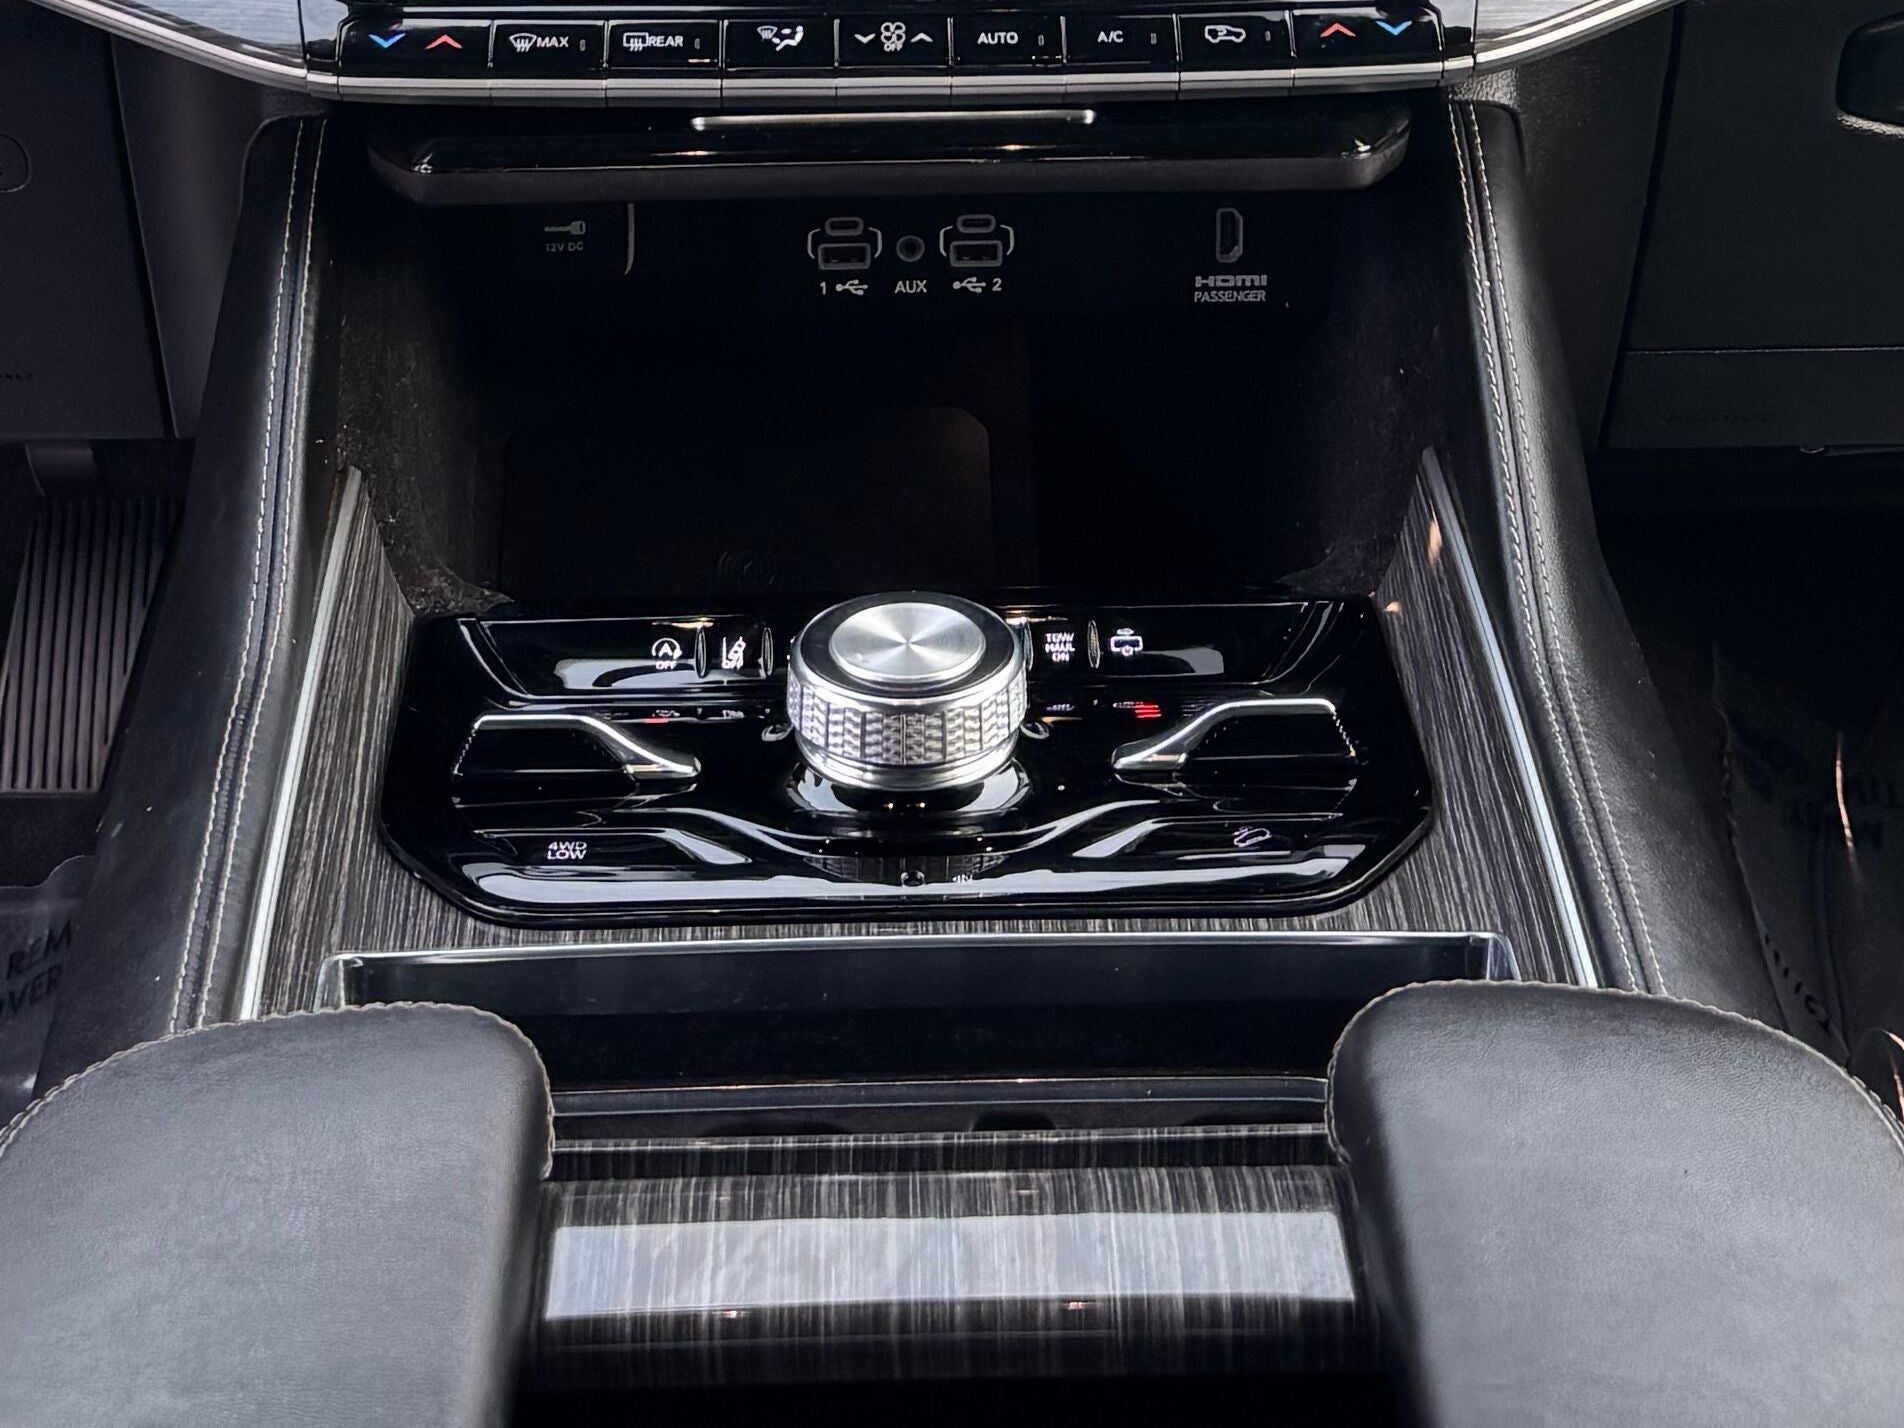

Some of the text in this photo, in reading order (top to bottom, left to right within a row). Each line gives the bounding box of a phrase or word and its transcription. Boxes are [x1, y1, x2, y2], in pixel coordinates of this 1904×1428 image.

[536, 35, 569, 49] MAX
[648, 34, 684, 48] REAR
[977, 31, 1019, 46] AUTO
[1097, 30, 1124, 44] A/C
[819, 281, 827, 295] 1
[894, 279, 928, 295] AUX
[992, 278, 1003, 293] 2
[1194, 275, 1268, 288] HDMI
[1193, 289, 1267, 303] PASSENGER
[548, 841, 587, 851] 4WD
[547, 850, 587, 860] LOW
